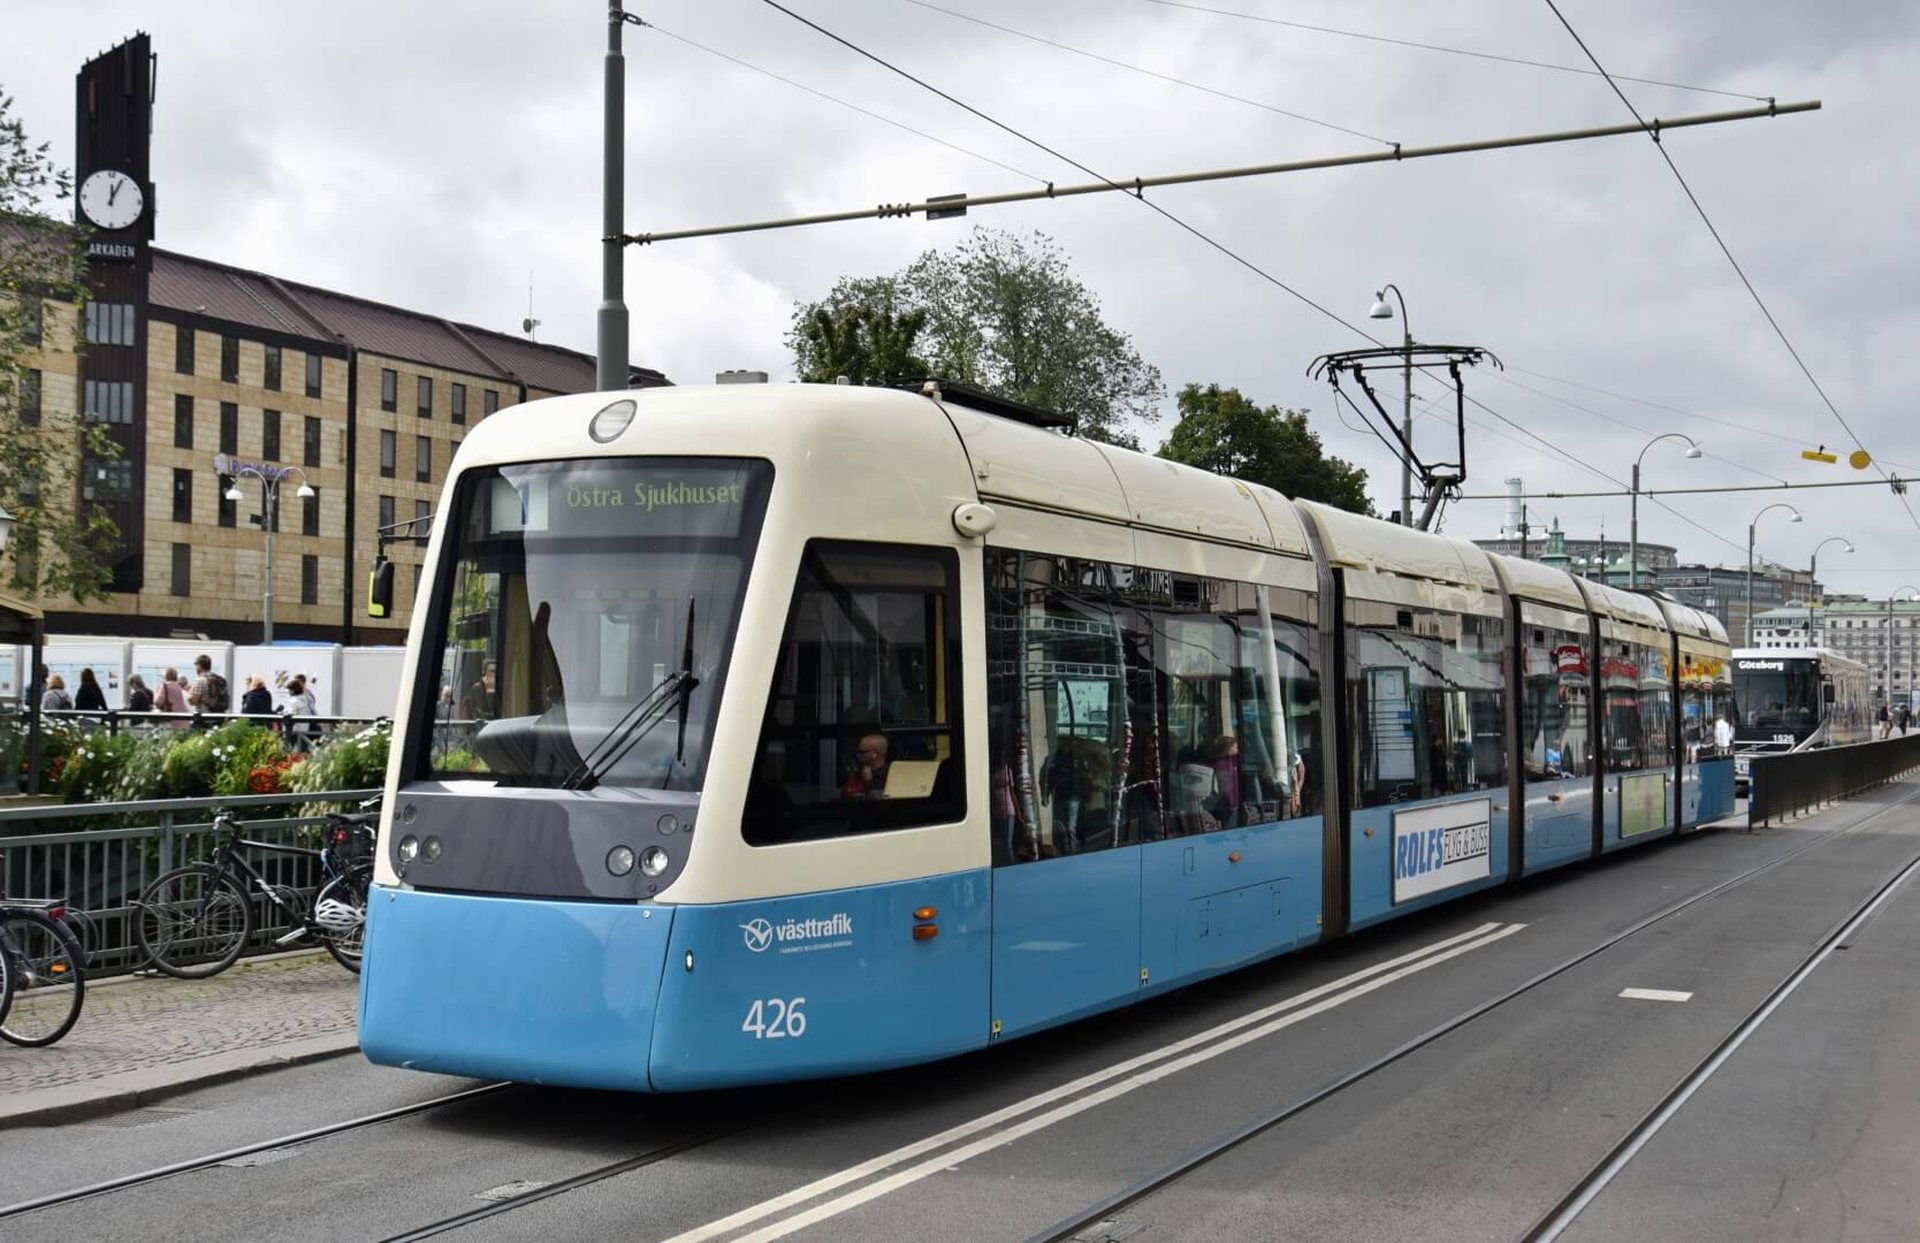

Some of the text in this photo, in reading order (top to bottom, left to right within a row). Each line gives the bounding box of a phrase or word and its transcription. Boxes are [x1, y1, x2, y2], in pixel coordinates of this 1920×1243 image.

[88, 243, 135, 257] ARKADEN
[566, 481, 741, 512] Östra Sjukhuset
[1396, 828, 1444, 879] ROLFS
[1444, 831, 1462, 860] FLYG
[1470, 825, 1488, 853] BUSS
[776, 913, 852, 941] västtrafik
[742, 997, 806, 1039] 426
